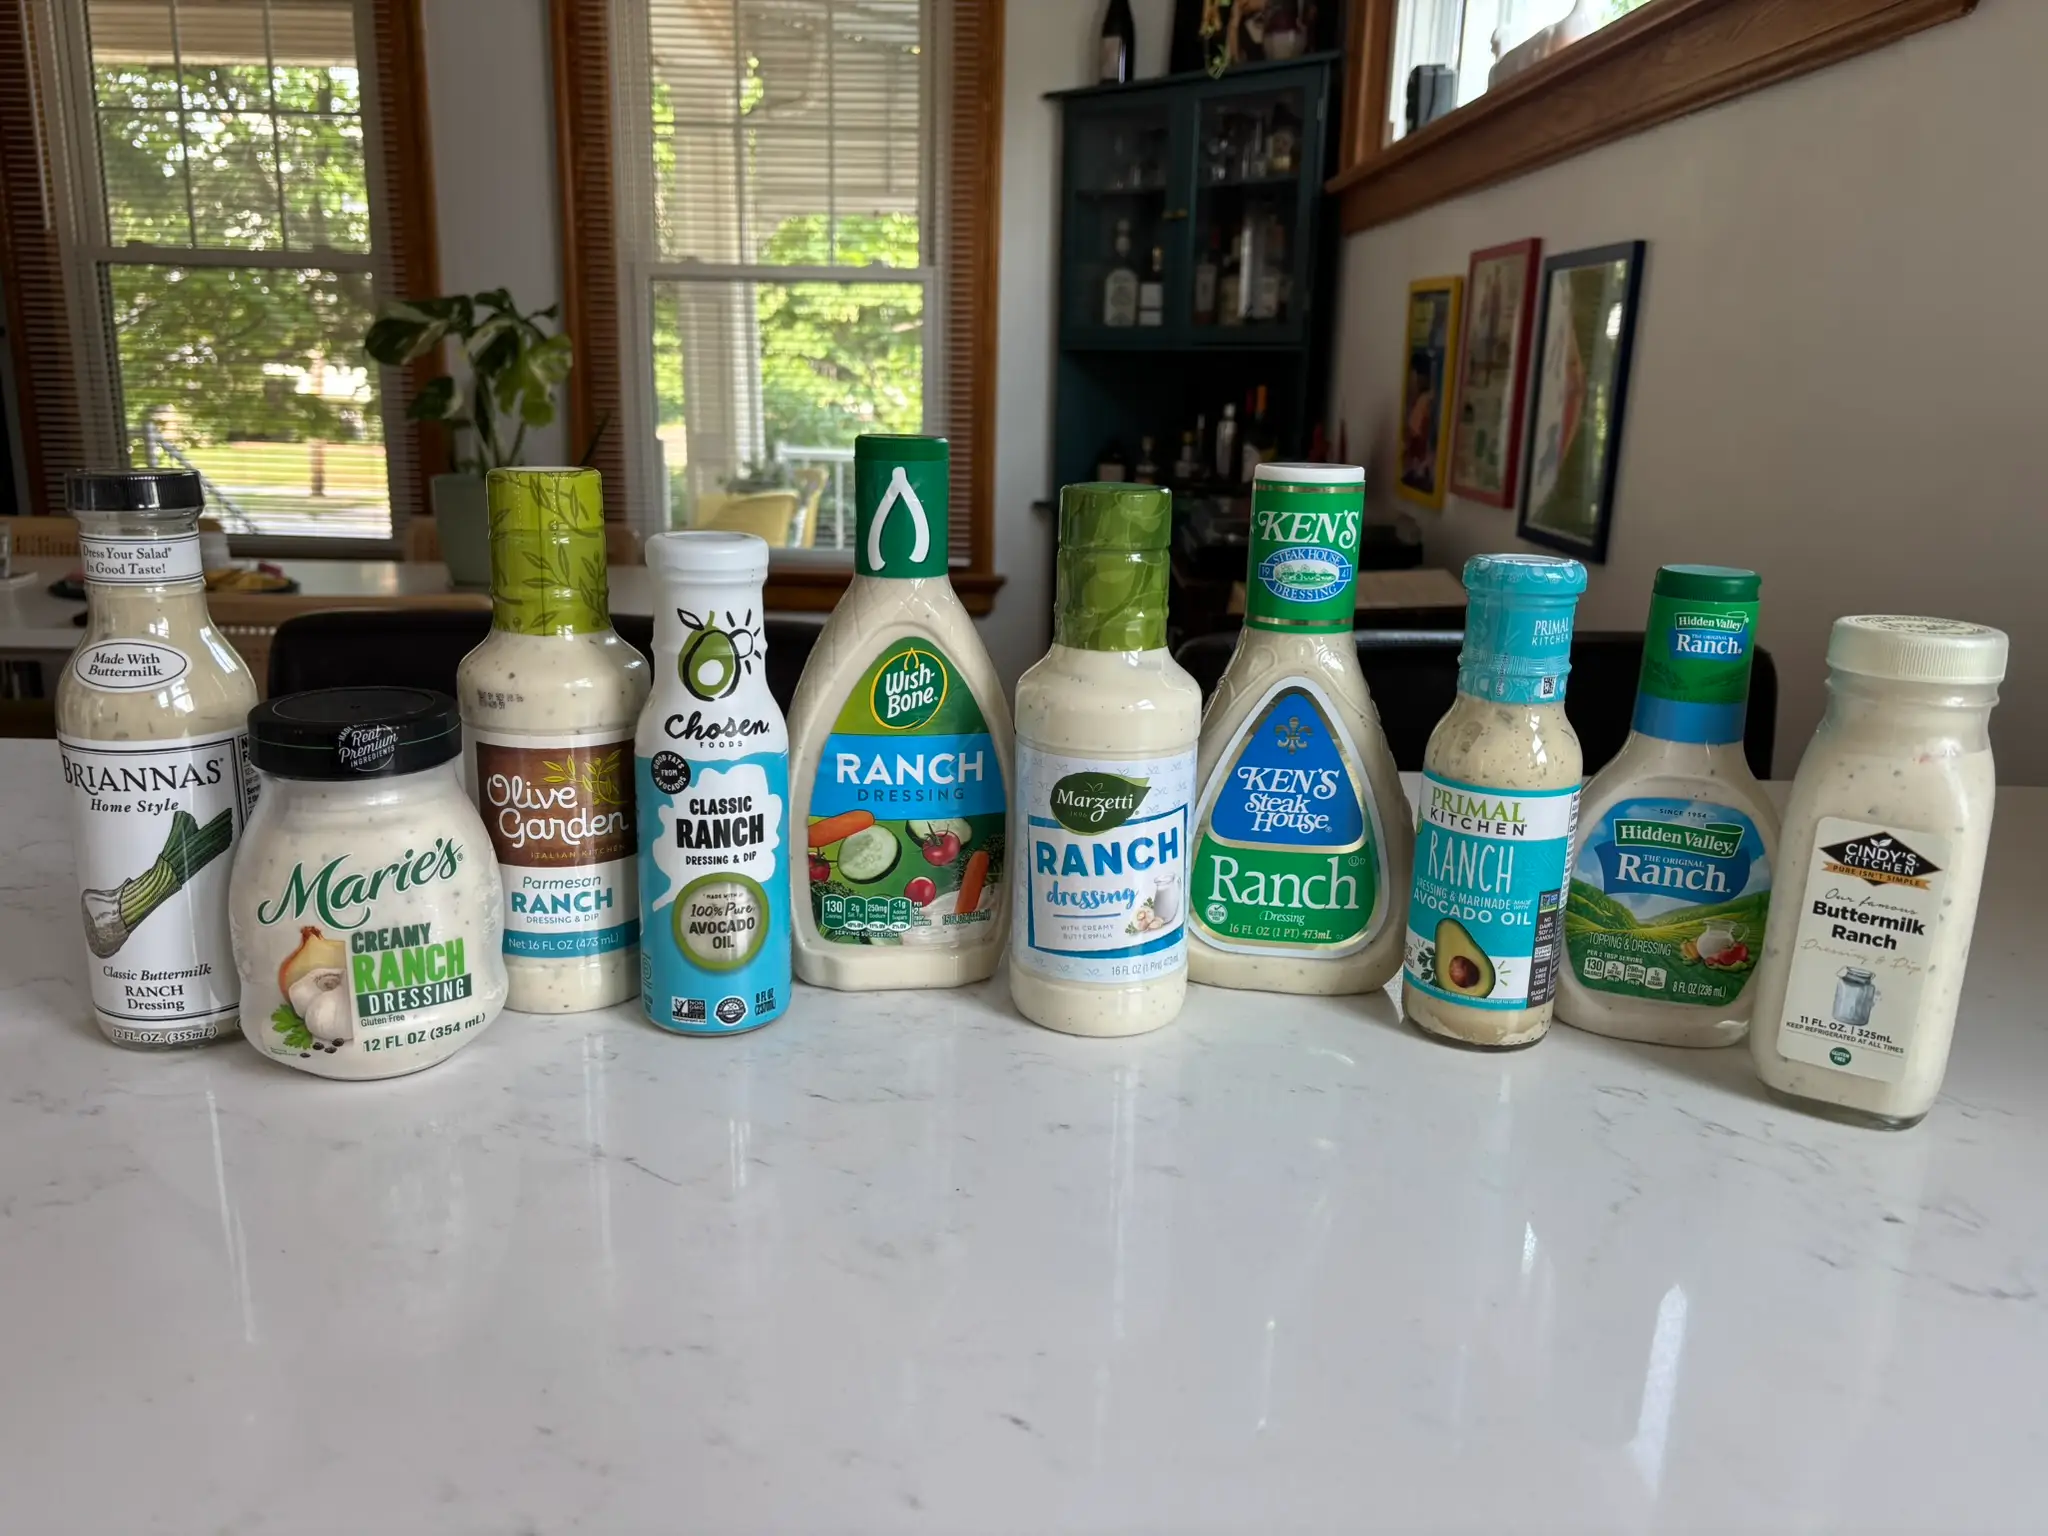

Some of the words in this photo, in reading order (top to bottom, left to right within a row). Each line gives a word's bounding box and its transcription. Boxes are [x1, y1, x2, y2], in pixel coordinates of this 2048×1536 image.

[1258, 510, 1359, 549] KEN'S
[83, 546, 105, 559] Dress
[106, 548, 133, 560] Your
[1273, 549, 1307, 564] STEAK
[1309, 549, 1341, 564] HOUSE
[86, 561, 95, 573] In
[95, 563, 125, 574] Good
[128, 563, 166, 574] Taste!
[1262, 568, 1270, 576] 19
[1341, 570, 1350, 578] 41
[1274, 584, 1337, 599] DRESSING
[1534, 618, 1569, 635] PRIMAL
[1678, 617, 1715, 626] Hidden
[1716, 618, 1741, 631] Valley
[1531, 634, 1569, 646] KITCHEN
[1676, 633, 1739, 654] Ranch
[93, 652, 124, 665] Made
[127, 654, 160, 664] With
[88, 665, 163, 677] Buttermilk
[887, 687, 934, 718] Bone
[352, 725, 381, 746] Real
[665, 711, 769, 741] Chosen
[339, 733, 398, 763] Premium
[700, 740, 743, 748] FOODS
[351, 745, 395, 767] INGREDIENTS
[668, 754, 685, 769] FATS
[62, 753, 221, 795] BRIANNAS
[837, 751, 983, 785] RANCH
[487, 773, 578, 810] Olive
[655, 776, 686, 791] AVOCADOS
[1237, 766, 1340, 799] KEN'S
[858, 788, 964, 801] DRESSING
[1245, 793, 1311, 814] Steak
[90, 798, 132, 813] Home
[137, 799, 179, 816] Style
[689, 795, 752, 815] CLASSIC
[1057, 788, 1133, 822] Marzetti
[1432, 786, 1525, 823] PRIMAL
[1659, 808, 1684, 817] SINCE
[1688, 811, 1707, 819] 1954
[499, 808, 629, 848] Garden
[676, 813, 764, 849] RANCH
[1251, 811, 1329, 833] House
[1430, 809, 1525, 836] KITCHEN
[1621, 825, 1681, 845] Hidden
[1684, 831, 1732, 855] Valley
[531, 851, 576, 859] ITALIAN
[685, 855, 728, 865] DRESSING
[733, 854, 739, 863] &
[744, 851, 757, 862] DIP
[1036, 827, 1178, 876] RANCH
[1846, 843, 1917, 866] CINDY'S
[1428, 830, 1514, 894] RANCH
[1643, 855, 1661, 863] THE
[1662, 857, 1705, 868] ORIGINAL
[1843, 855, 1915, 875] KITCHEN
[1615, 852, 1726, 893] Ranch
[1833, 865, 1856, 876] PURE
[1859, 870, 1884, 881] ISN'T
[1887, 874, 1921, 887] SIMPLE
[257, 837, 463, 929] Marie's
[523, 876, 601, 889] Parmesan
[1208, 855, 1359, 910] Ranch
[511, 888, 613, 914] RANCH
[893, 900, 906, 909] <1g
[1047, 880, 1139, 910] dressing
[1450, 891, 1456, 900] &
[1459, 893, 1510, 910] MARINADE
[1825, 888, 1854, 902] Our
[1859, 896, 1917, 915] famous
[690, 904, 723, 917] 100%
[725, 902, 753, 916] Pure
[825, 900, 842, 912] 130
[851, 904, 859, 912] 2g
[868, 904, 887, 913] 250mg
[1414, 888, 1492, 923] AVOCADO
[1501, 912, 1531, 925] OIL
[527, 916, 572, 924] DRESSING
[584, 913, 600, 921] DIP
[689, 917, 755, 934] AVOCADO
[1260, 911, 1305, 926] Dressing
[1812, 900, 1926, 936] Buttermilk
[352, 923, 431, 954] CREAMY
[1229, 923, 1239, 933] 16
[1242, 925, 1252, 935] FL
[1256, 926, 1270, 936] OZ
[1284, 928, 1300, 938] PT)
[1302, 930, 1332, 939] 473mL
[1831, 924, 1897, 950] Ranch
[508, 938, 526, 948] Net
[528, 940, 539, 950] 16
[543, 940, 555, 950] FL
[557, 940, 574, 950] OZ
[576, 937, 598, 950] (473
[712, 936, 735, 949] OIL
[1589, 932, 1623, 950] TOPPING
[1624, 938, 1630, 950] &
[1631, 939, 1672, 956] DRESSING
[103, 966, 137, 981] Classic
[140, 963, 211, 981] Buttermilk
[352, 939, 464, 993] RANCH
[1111, 966, 1120, 976] 16
[1122, 966, 1129, 975] FL
[1586, 958, 1602, 970] 130
[125, 985, 184, 997] RANCH
[369, 978, 464, 1015] DRESSING
[1672, 982, 1678, 992] 8
[1678, 982, 1686, 993] FL
[1688, 983, 1697, 994] OZ
[127, 998, 185, 1012] Dressing
[361, 1017, 387, 1028] Gluten
[388, 1014, 405, 1024] Free
[1800, 1015, 1808, 1024] 11
[1812, 1018, 1827, 1028] FL.
[1829, 1022, 1847, 1033] OZ.
[1857, 1029, 1893, 1043] 325mL
[112, 1029, 122, 1038] 12
[140, 1032, 164, 1042] OZ.
[363, 1039, 380, 1053] 12
[385, 1035, 403, 1049] FL
[407, 1031, 426, 1045] OZ
[430, 1024, 460, 1042] (354
[465, 1013, 486, 1030] mL)
[1805, 1026, 1856, 1042] REFRIGERATED
[1883, 1044, 1904, 1053] TIMES
